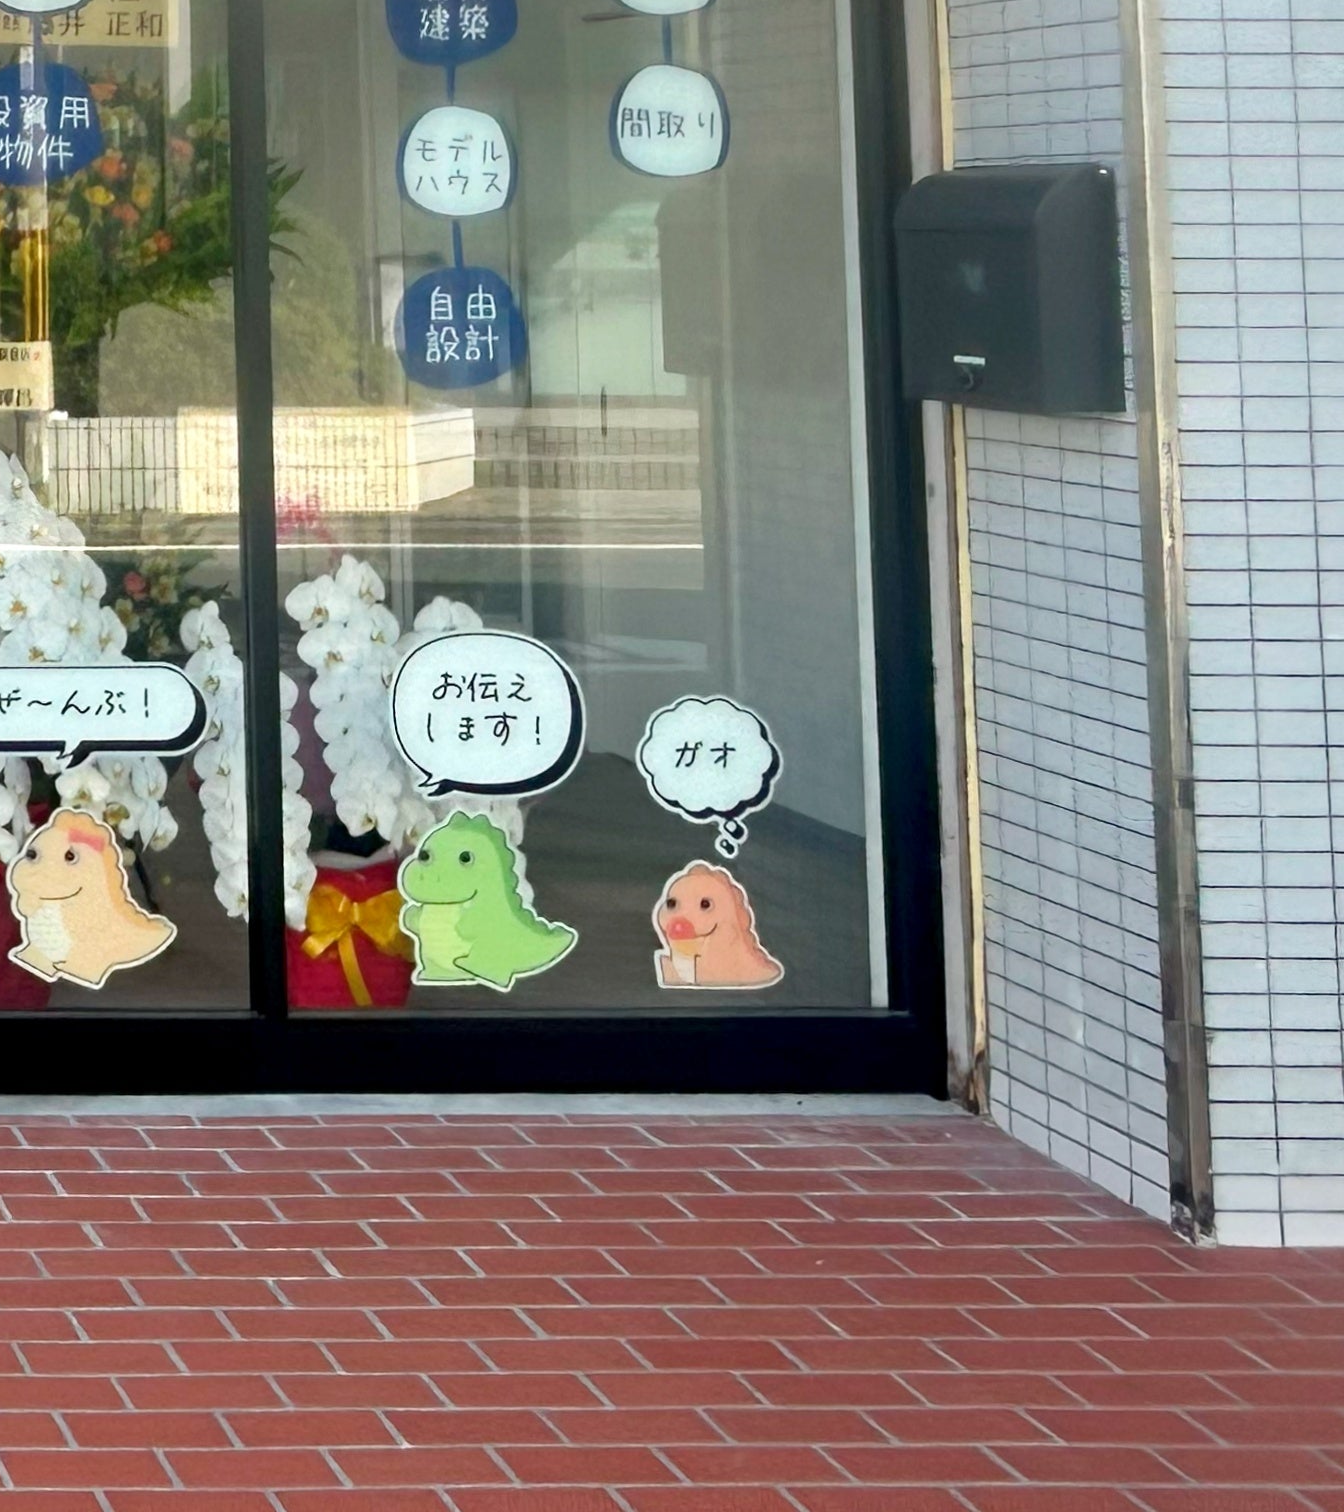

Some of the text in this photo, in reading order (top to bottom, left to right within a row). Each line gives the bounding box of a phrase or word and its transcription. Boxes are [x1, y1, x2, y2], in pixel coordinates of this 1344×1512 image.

[106, 10, 163, 38] 正和
[419, 2, 491, 41] 建築
[620, 107, 716, 139] 間取り
[415, 136, 504, 164] モデル
[415, 170, 504, 195] ハウス
[429, 286, 498, 322] 自由
[425, 324, 500, 364] 設計
[432, 671, 534, 704] お伝え
[674, 739, 737, 769] ガオ
